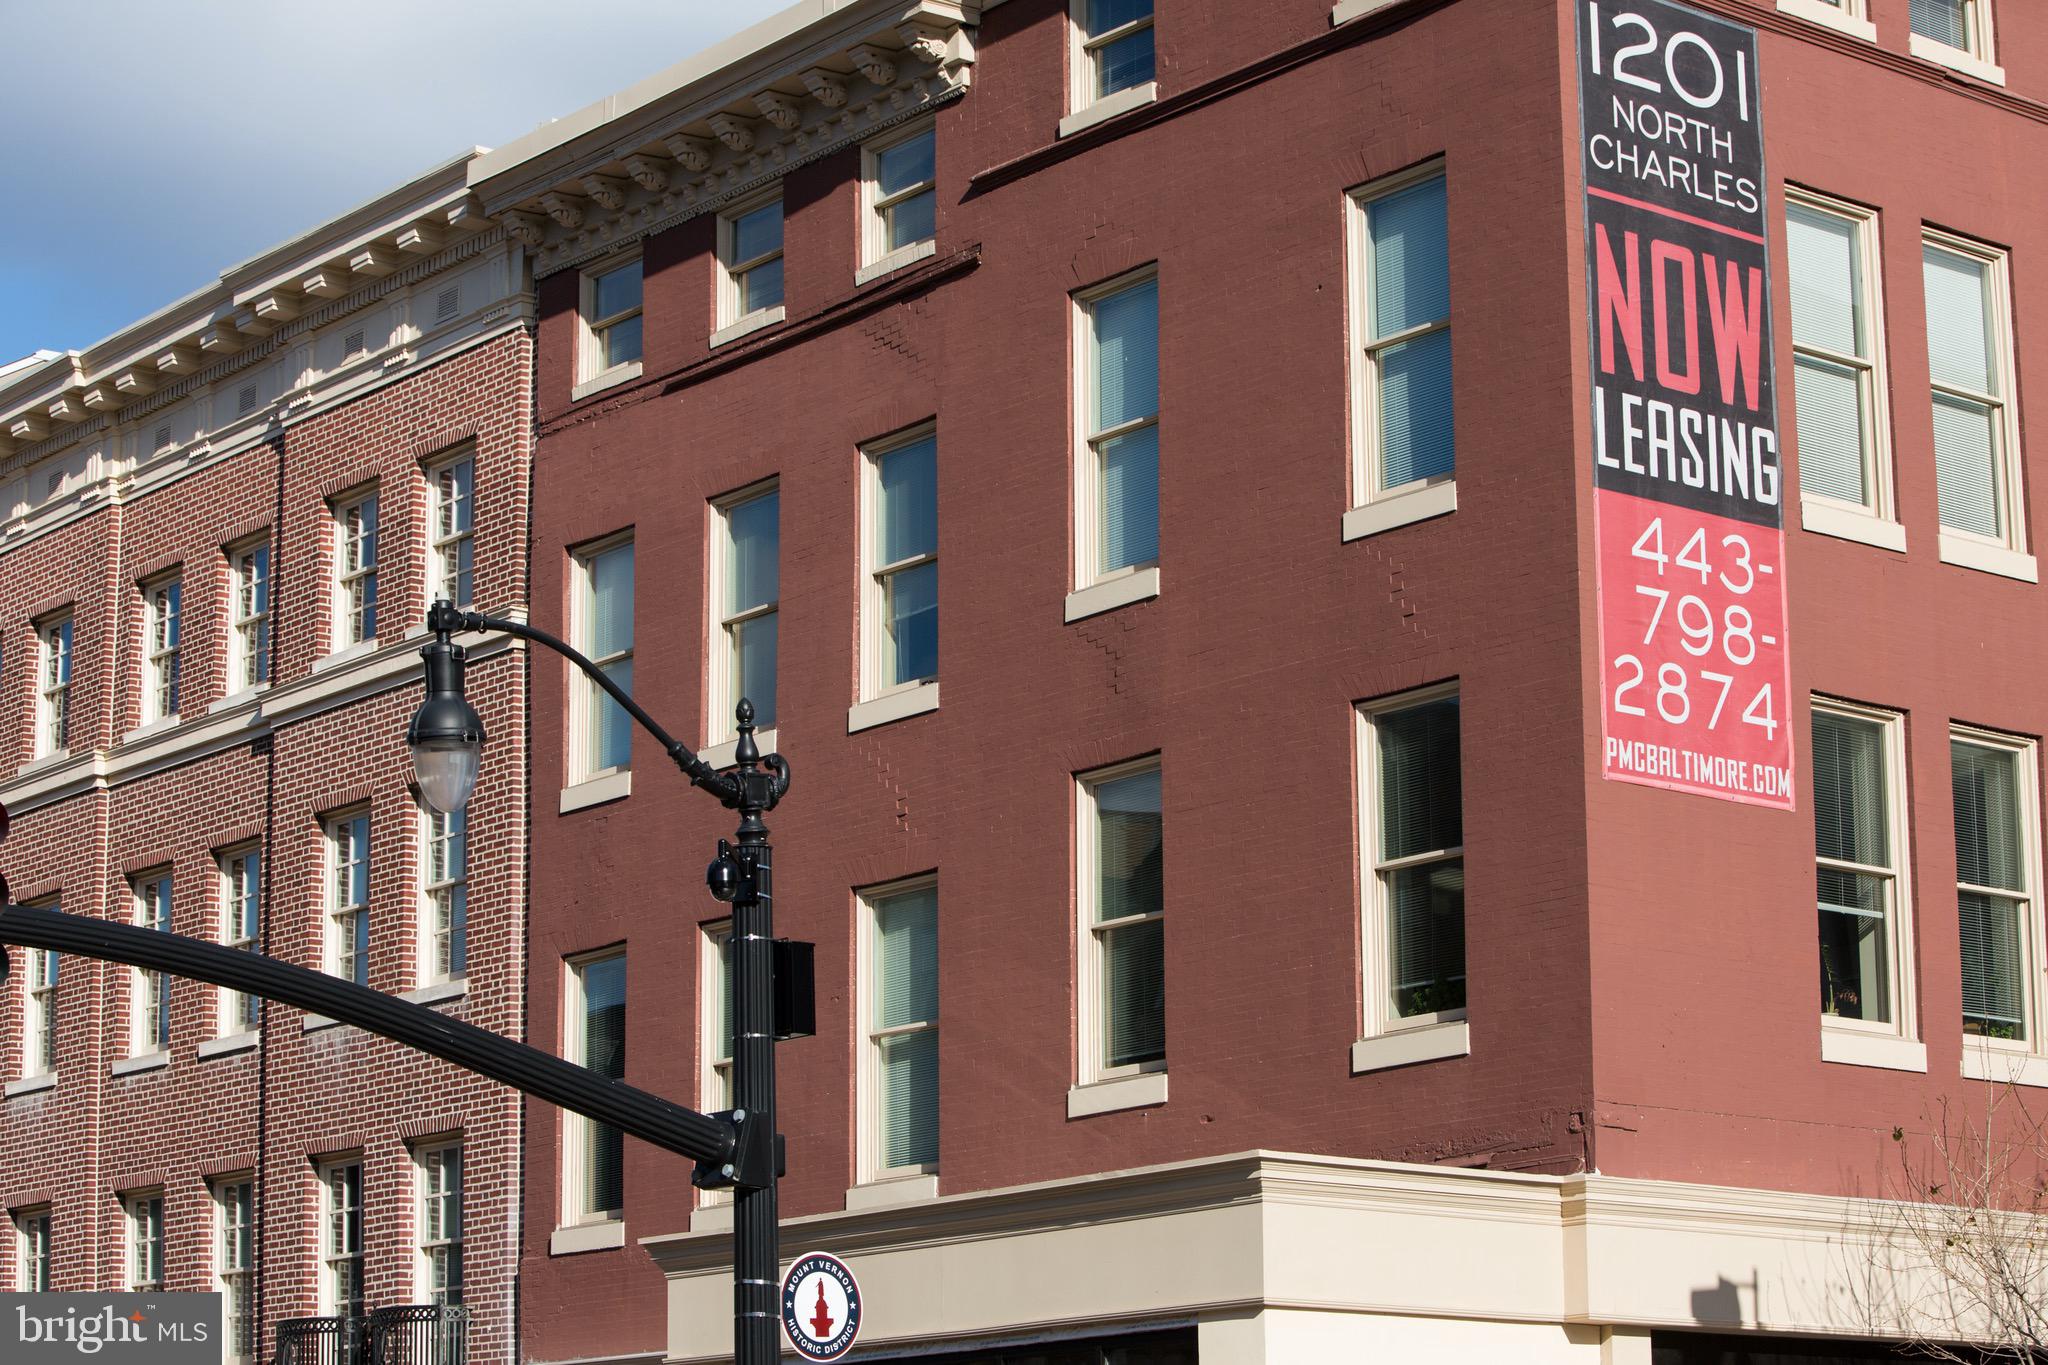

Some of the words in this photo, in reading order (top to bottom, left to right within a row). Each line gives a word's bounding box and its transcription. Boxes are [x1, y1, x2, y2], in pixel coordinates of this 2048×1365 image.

[1589, 1, 1749, 122] 1201
[1612, 95, 1733, 164] NORTH
[1589, 134, 1759, 213] CHARLES
[1595, 222, 1762, 412] NOW
[1595, 386, 1778, 506] LEASING
[1631, 517, 1773, 595] 443-
[1636, 584, 1776, 666] 798-
[1614, 654, 1778, 741] 2874
[1606, 736, 1791, 798] PMCBALTIMORE.COM
[787, 1261, 814, 1293] MOUNT
[818, 1260, 854, 1294] VERNON
[787, 1318, 822, 1354] HISTORIC
[824, 1318, 856, 1354] DISTRICT
